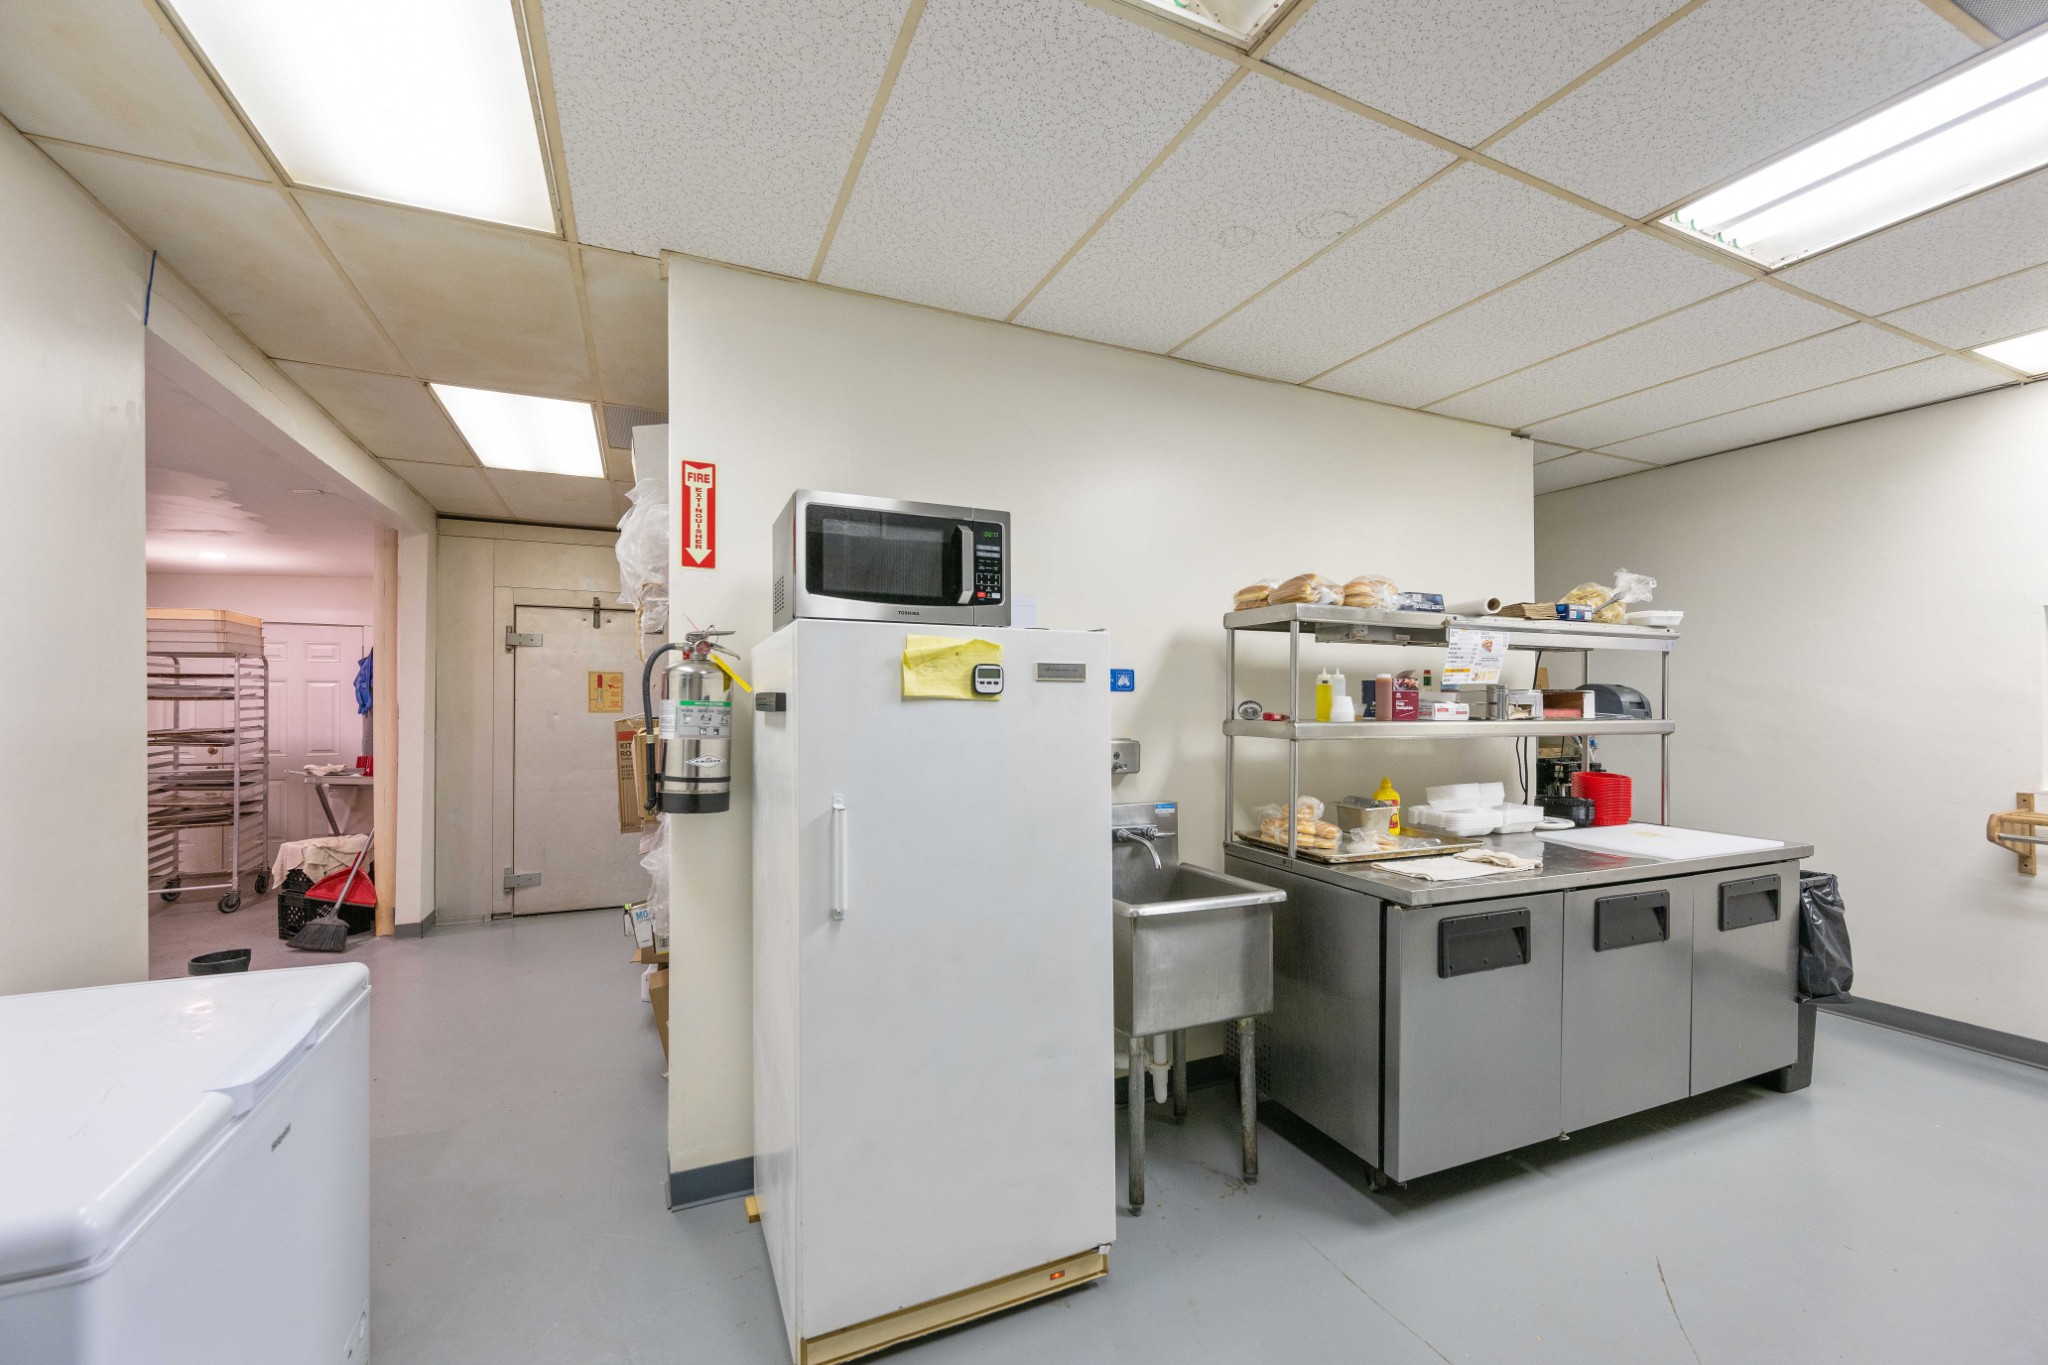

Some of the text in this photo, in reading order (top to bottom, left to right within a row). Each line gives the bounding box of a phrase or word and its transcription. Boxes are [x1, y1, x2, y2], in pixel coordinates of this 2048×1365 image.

[687, 472, 710, 483] FIRE
[695, 487, 703, 550] EXTINGUISHER
[620, 742, 632, 750] KIT
